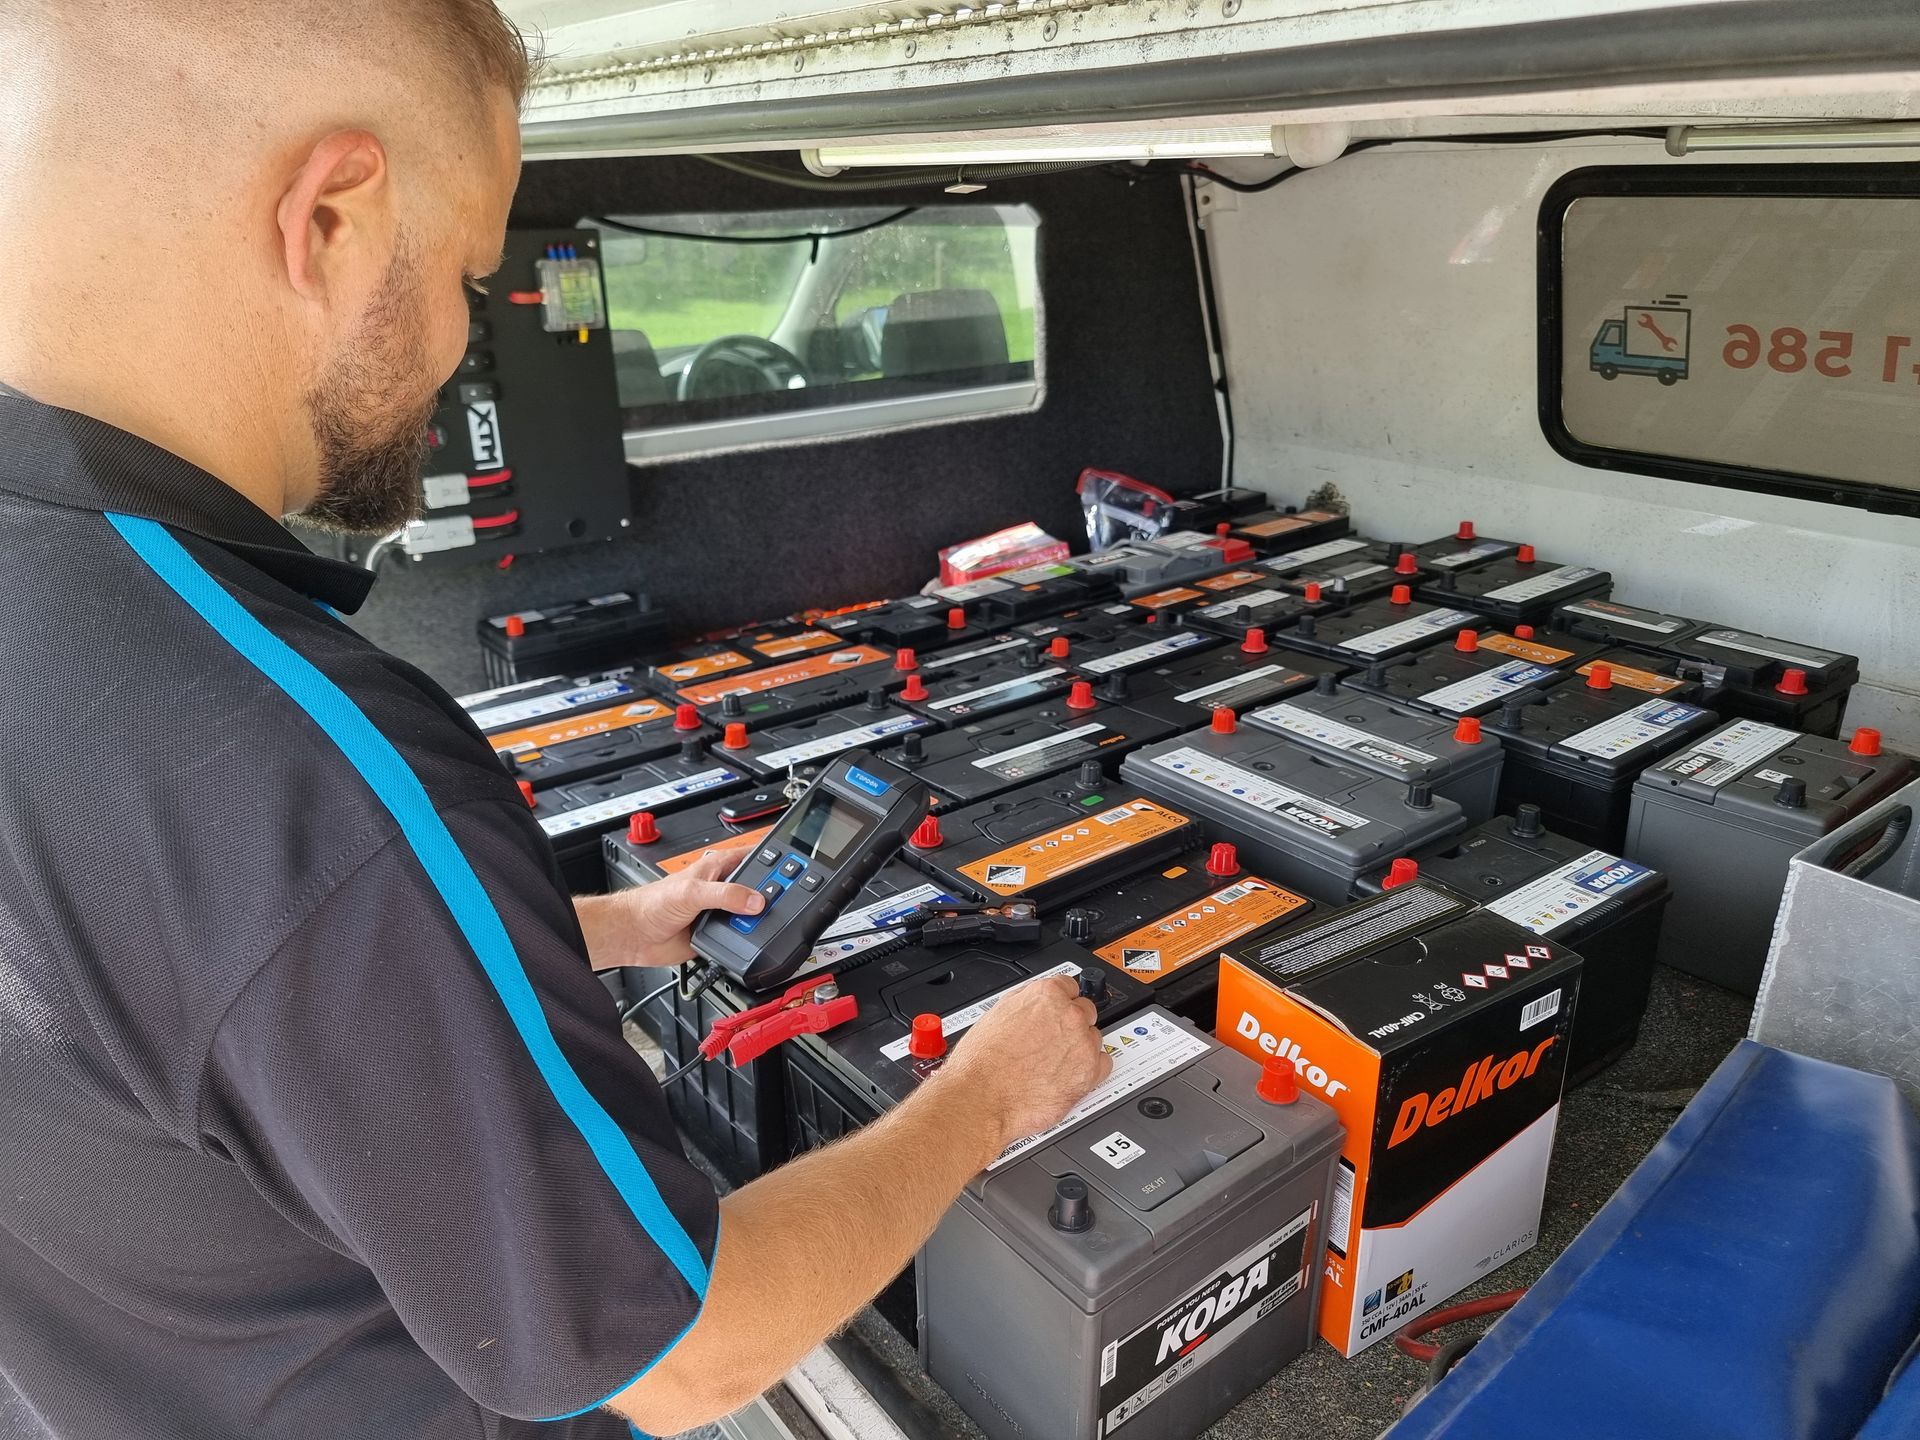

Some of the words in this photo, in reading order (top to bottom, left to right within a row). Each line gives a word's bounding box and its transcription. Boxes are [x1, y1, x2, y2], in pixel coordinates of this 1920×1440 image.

[1507, 668, 1543, 683] KOBA
[1653, 707, 1689, 724] KOBA
[1358, 745, 1411, 766] KOBA
[1675, 755, 1713, 775] KOBA
[1155, 810, 1183, 824] ALCO
[1284, 806, 1342, 832] KOBA
[785, 863, 794, 872] M
[805, 873, 817, 884] EXIT
[1587, 864, 1634, 890] KOBA
[1268, 890, 1299, 904] ALCO
[878, 906, 897, 920] SMF
[1368, 1011, 1426, 1039] CMF-40AL
[1236, 1010, 1348, 1097] Delkor
[1387, 1034, 1557, 1149] Delkor
[1492, 1229, 1534, 1261] CLARIOS
[1156, 1306, 1184, 1330] POWER
[1185, 1295, 1200, 1309] YOU
[1201, 1280, 1221, 1299] NEED
[1260, 1289, 1281, 1308] START
[1281, 1279, 1299, 1296] STOP
[1155, 1256, 1271, 1366] KOBA
[1360, 1294, 1426, 1341] CMF-40AL
[1371, 1309, 1383, 1322] CCA
[1385, 1302, 1396, 1315] 12V
